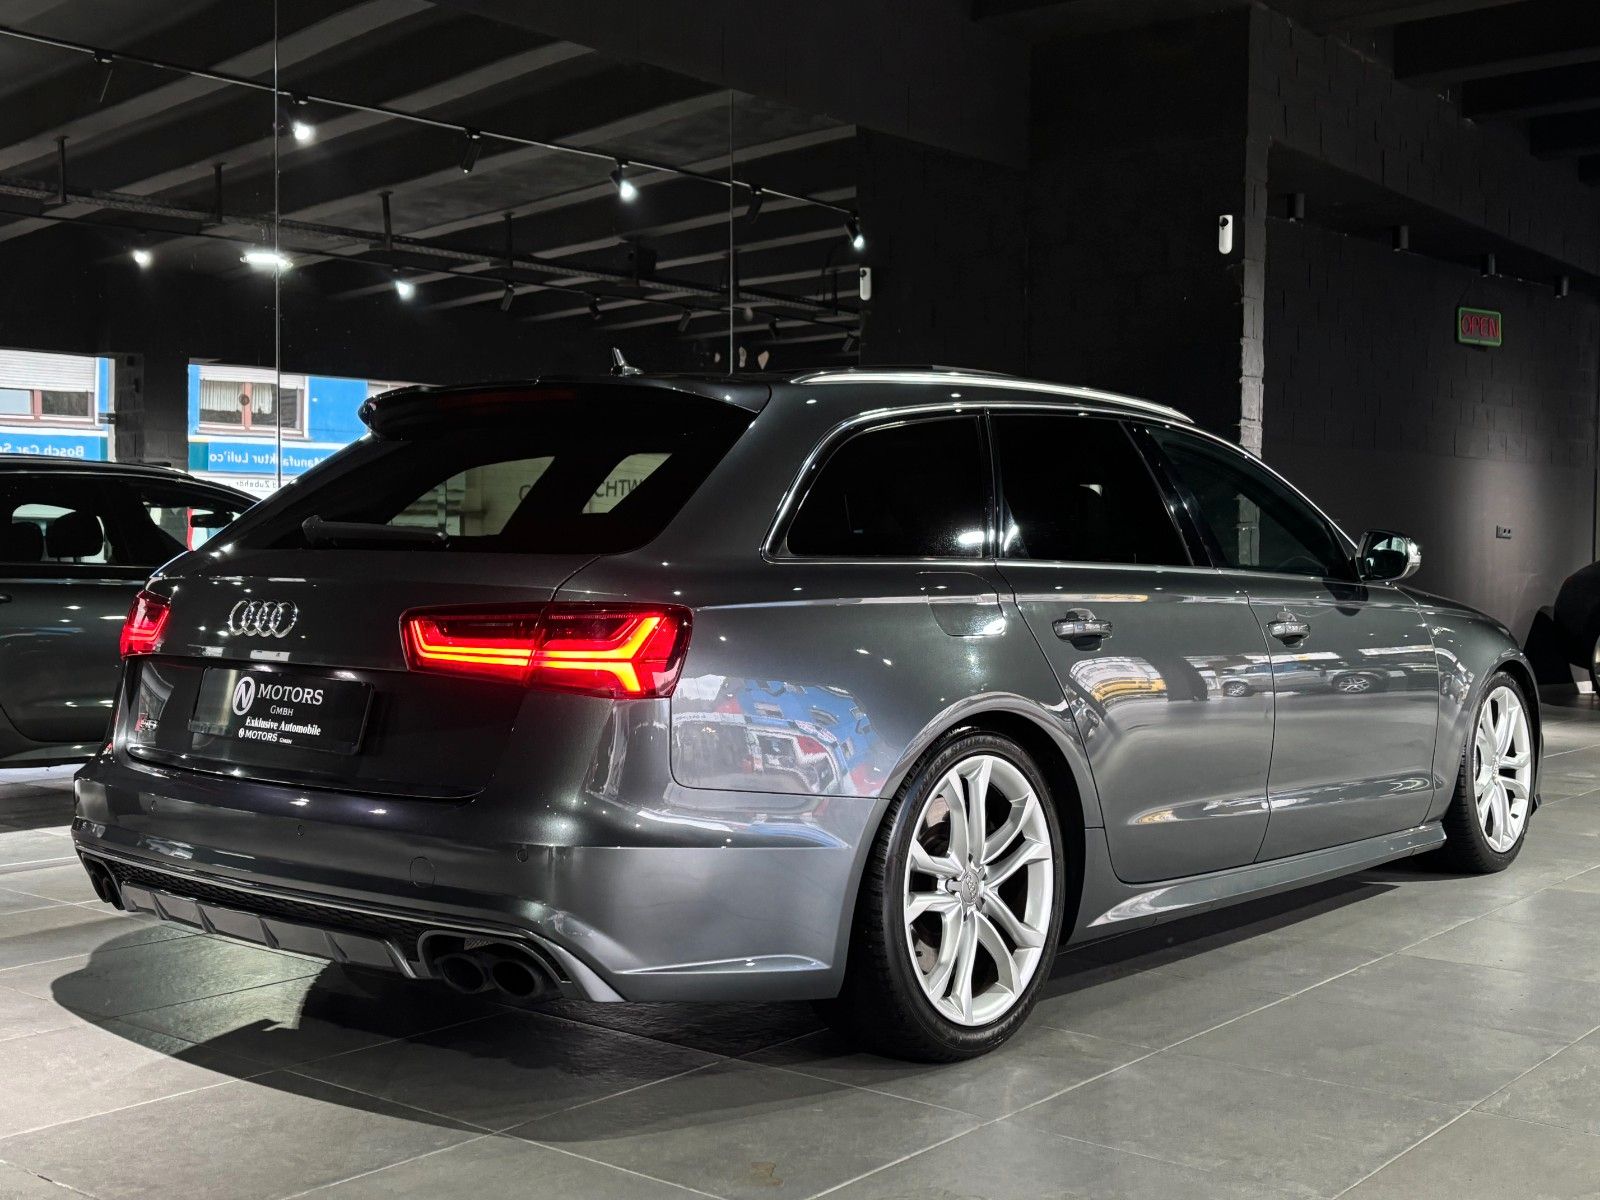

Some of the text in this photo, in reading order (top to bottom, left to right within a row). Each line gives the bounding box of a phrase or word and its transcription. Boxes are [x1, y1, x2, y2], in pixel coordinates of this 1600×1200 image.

[1461, 313, 1499, 338] OPEN
[257, 683, 324, 706] MOTORS
[270, 705, 294, 717] GMBH
[245, 716, 321, 736] Exklusive Automobile
[245, 729, 278, 742] MOTORS
